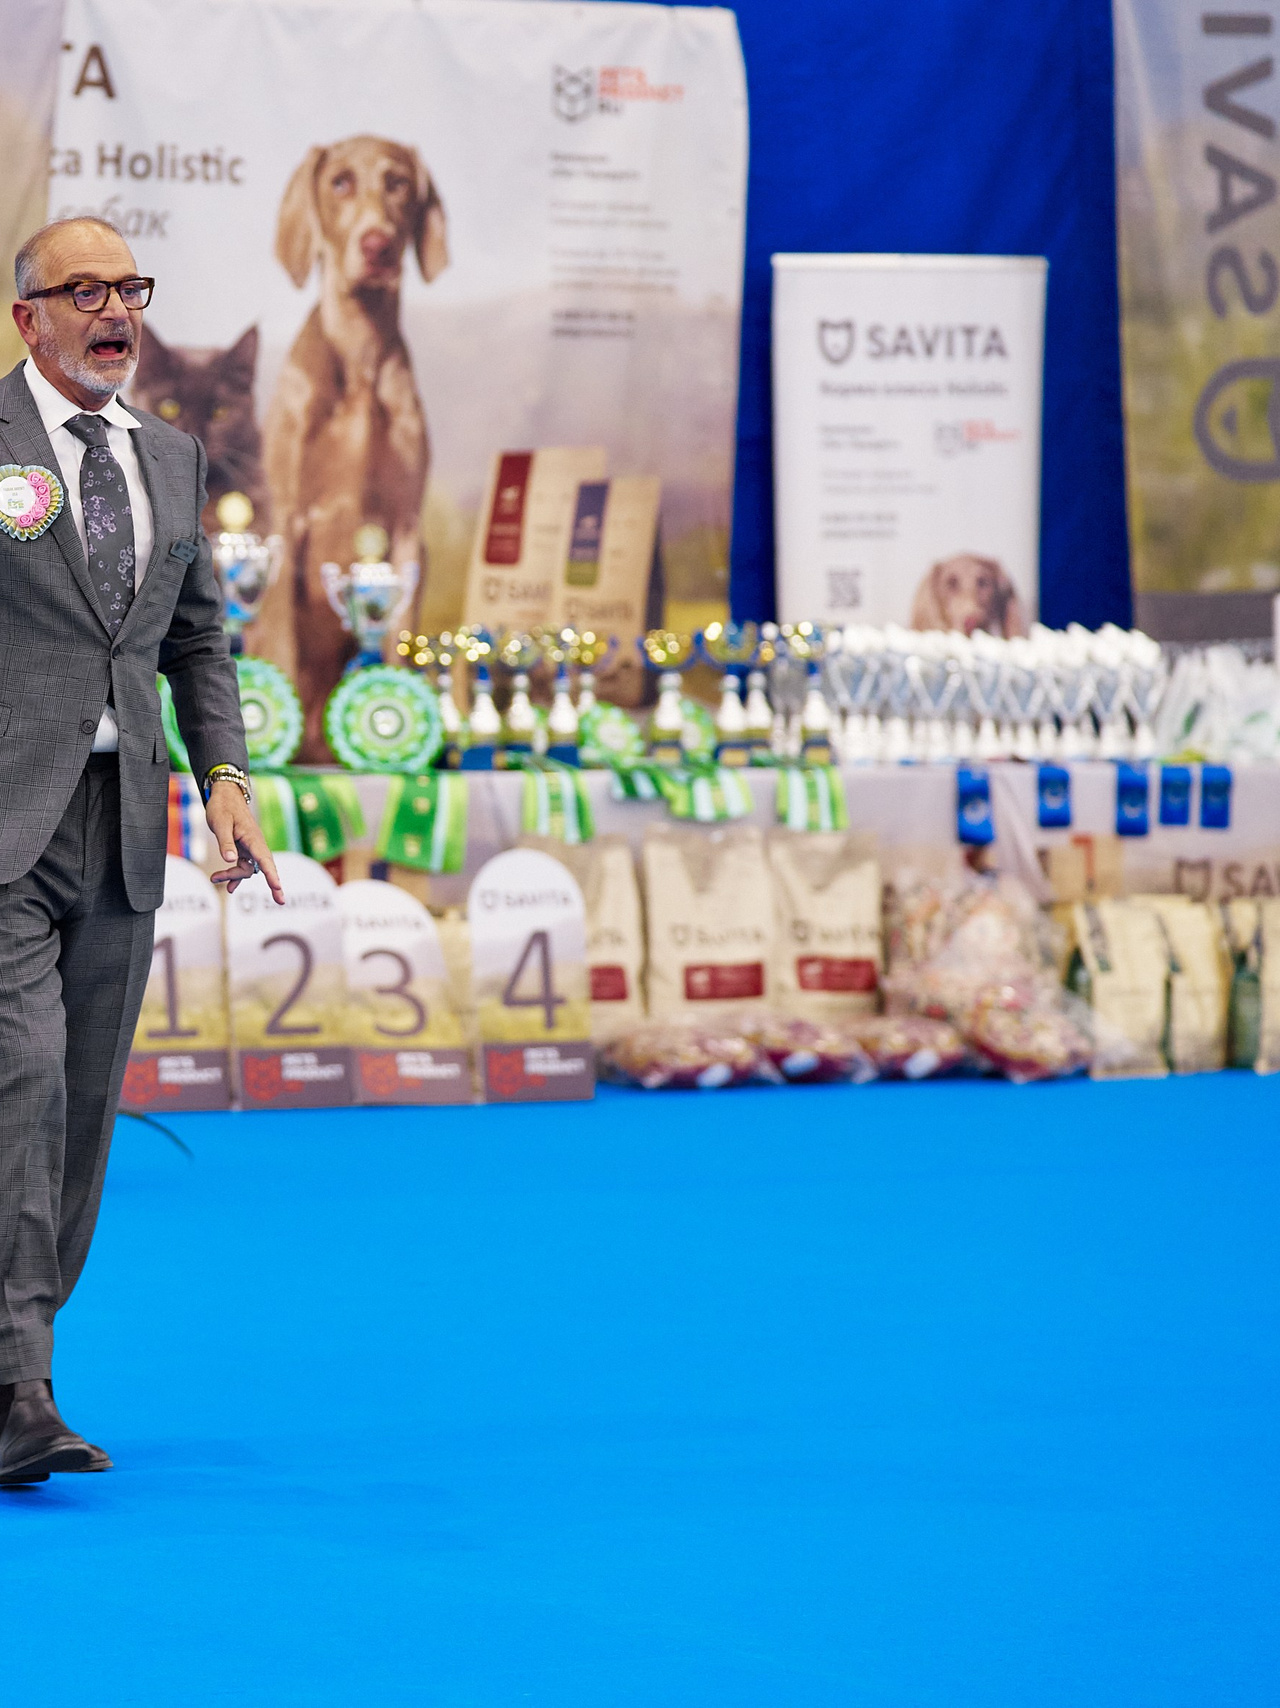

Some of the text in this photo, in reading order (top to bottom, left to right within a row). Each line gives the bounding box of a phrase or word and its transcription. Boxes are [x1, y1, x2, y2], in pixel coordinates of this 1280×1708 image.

[95, 143, 245, 185] Holistic
[866, 323, 1009, 359] SAVITA
[1220, 862, 1280, 903] SA
[146, 935, 198, 1039] 1
[261, 933, 321, 1037] 2
[359, 949, 428, 1038] 3
[501, 929, 566, 1032] 4
